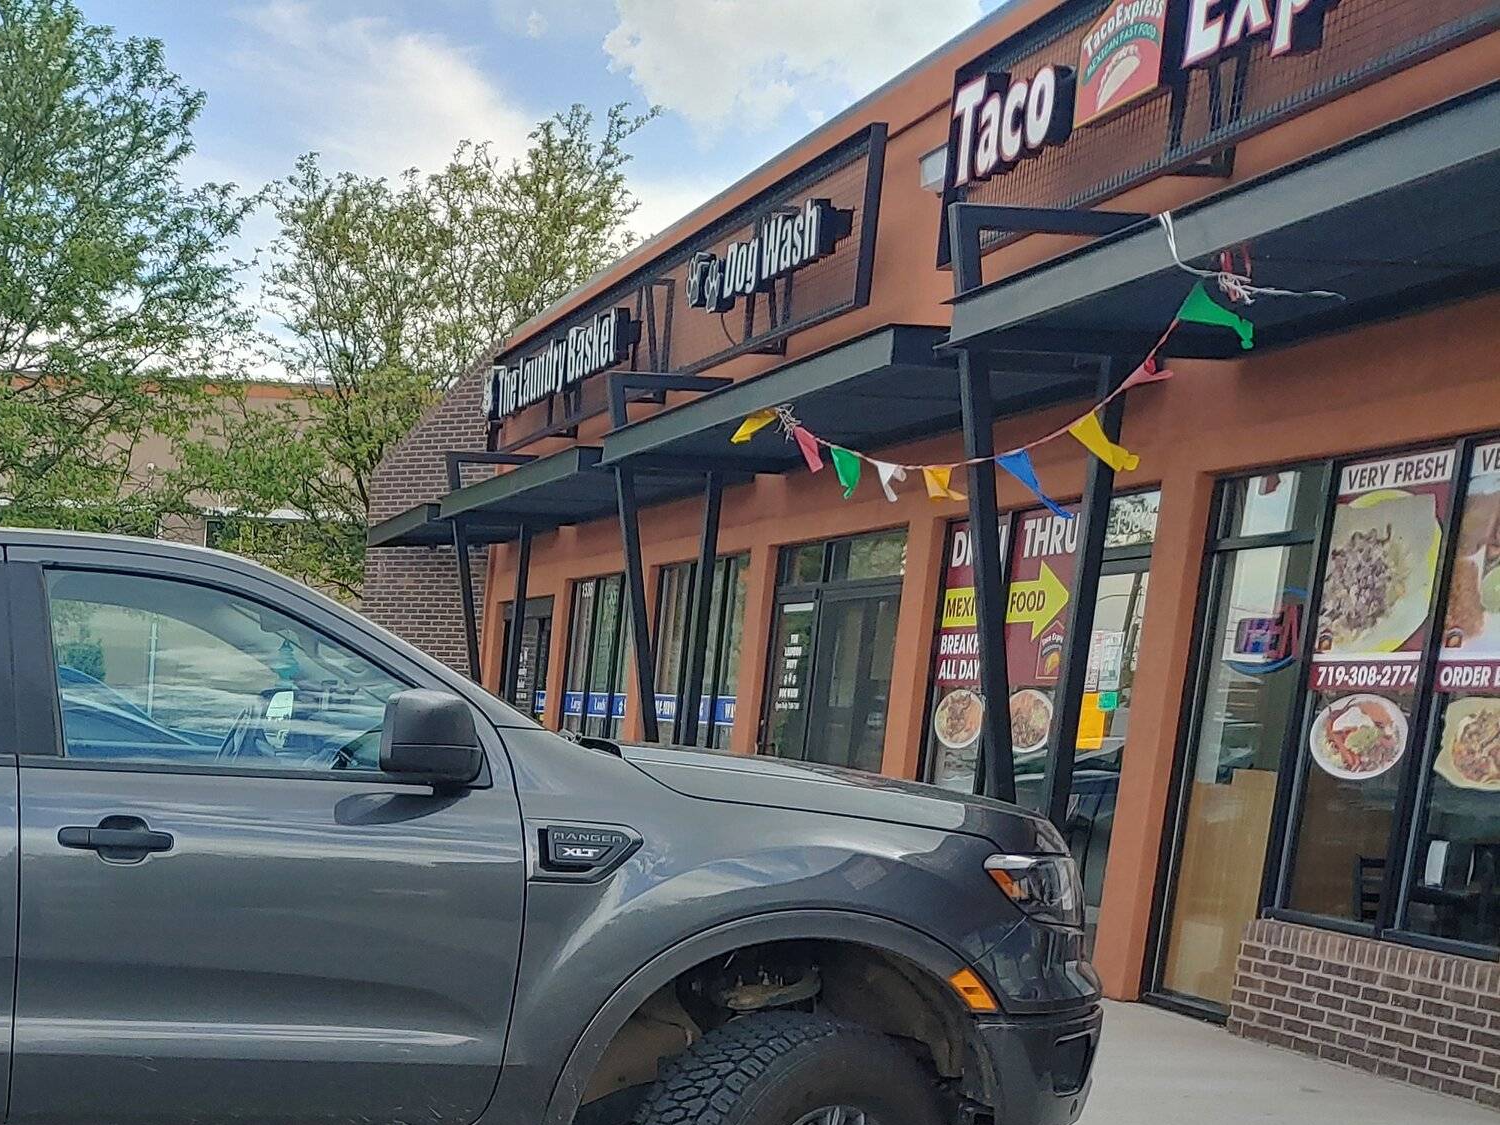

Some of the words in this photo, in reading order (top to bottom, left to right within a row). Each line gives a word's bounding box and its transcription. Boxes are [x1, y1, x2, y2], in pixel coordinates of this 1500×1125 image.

[1087, 37, 1119, 77] MEXICAN
[1119, 25, 1139, 45] FAST
[1140, 22, 1157, 39] FOOD
[953, 65, 1056, 189] Taco
[723, 237, 758, 299] Dog
[762, 198, 817, 280] Wash
[498, 366, 520, 418] The
[517, 339, 567, 408] Laundry
[566, 308, 616, 383] Basket
[1348, 463, 1390, 491] VERY
[1393, 455, 1448, 484] FRESH
[1023, 512, 1080, 558] THRU
[946, 595, 976, 618] MEXI
[1010, 590, 1046, 613] FOOD
[940, 634, 979, 655] BREAK
[938, 660, 957, 680] ALL
[959, 660, 980, 680] DAY
[1316, 665, 1419, 687] 719-308-2774
[1440, 665, 1490, 687] ORDER
[553, 832, 623, 843] RANGER
[562, 847, 599, 858] XLT
